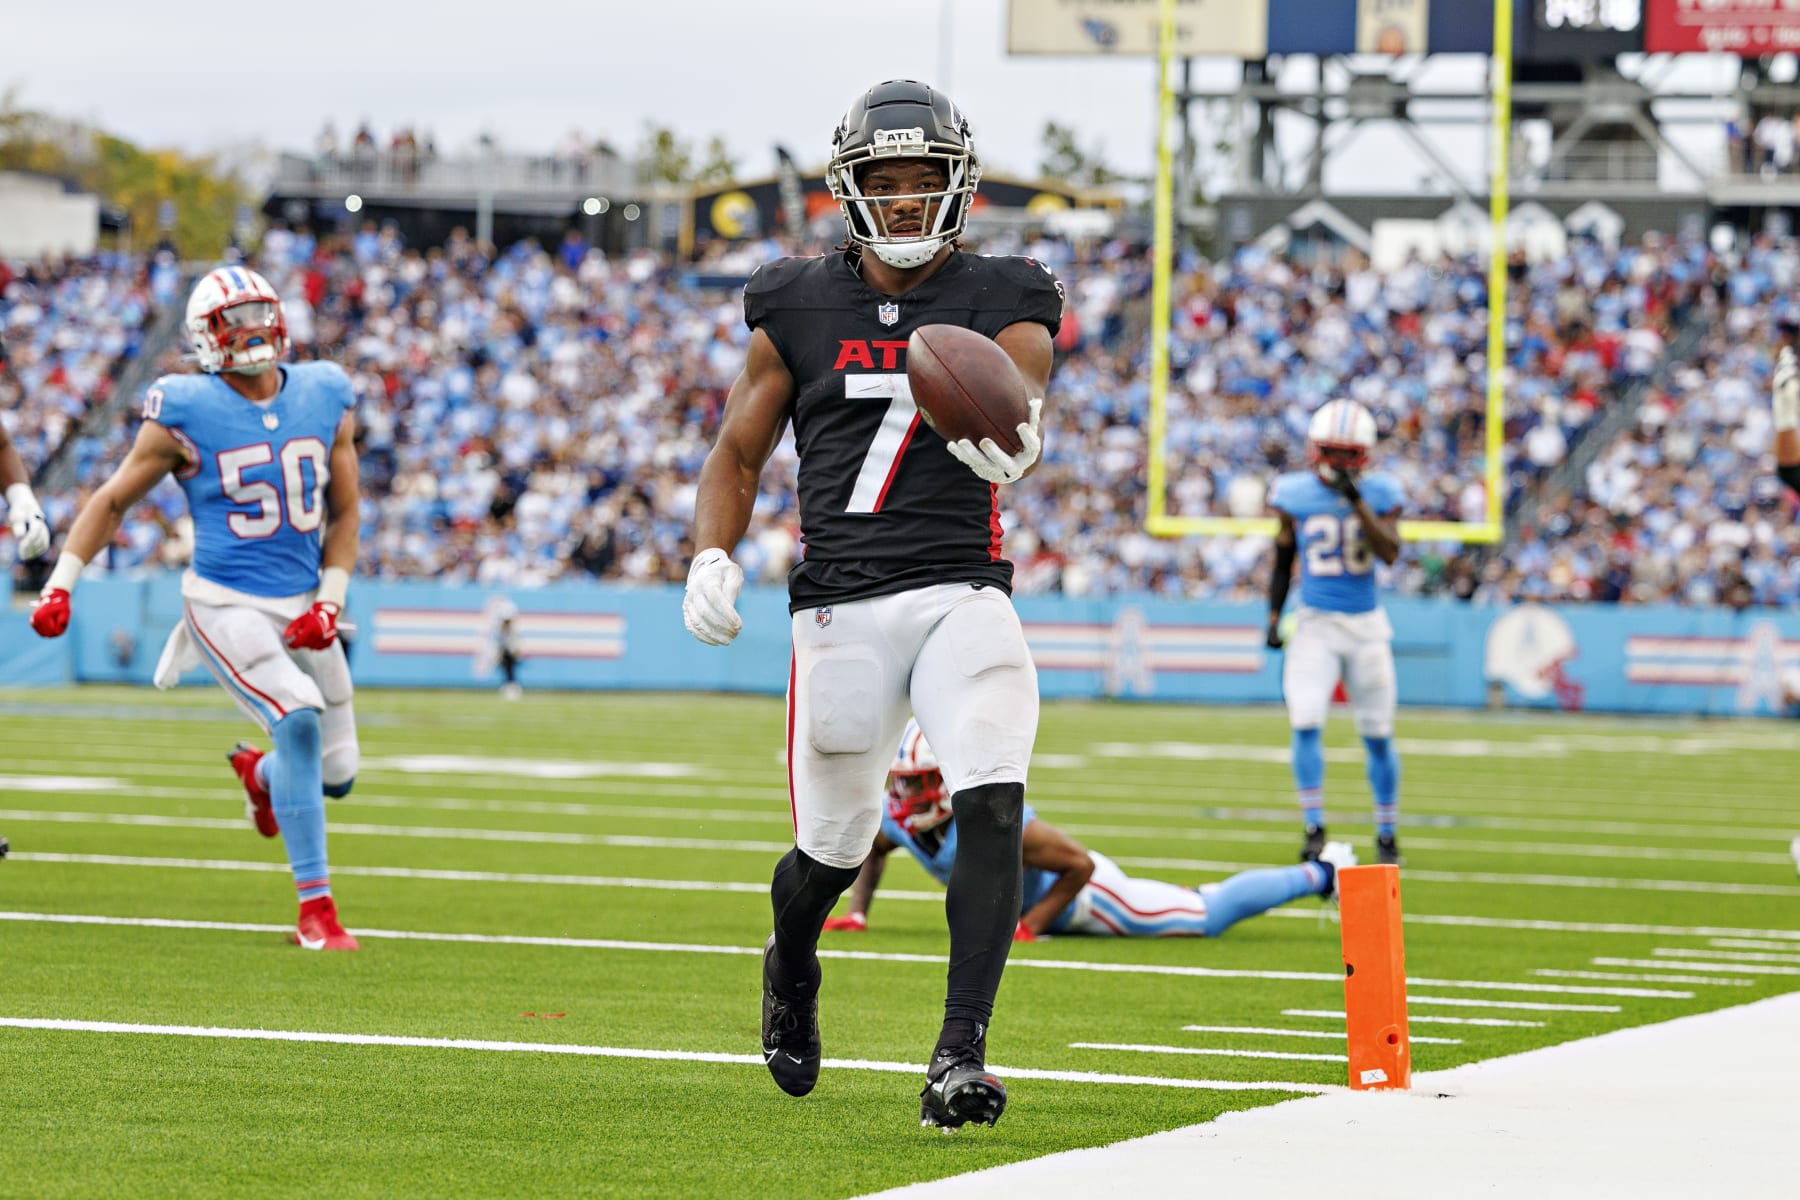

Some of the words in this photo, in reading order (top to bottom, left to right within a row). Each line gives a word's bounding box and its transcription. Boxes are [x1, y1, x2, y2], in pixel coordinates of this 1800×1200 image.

[887, 132, 912, 141] ATL
[833, 340, 910, 370] AT
[845, 374, 919, 513] 7
[216, 436, 329, 539] 50
